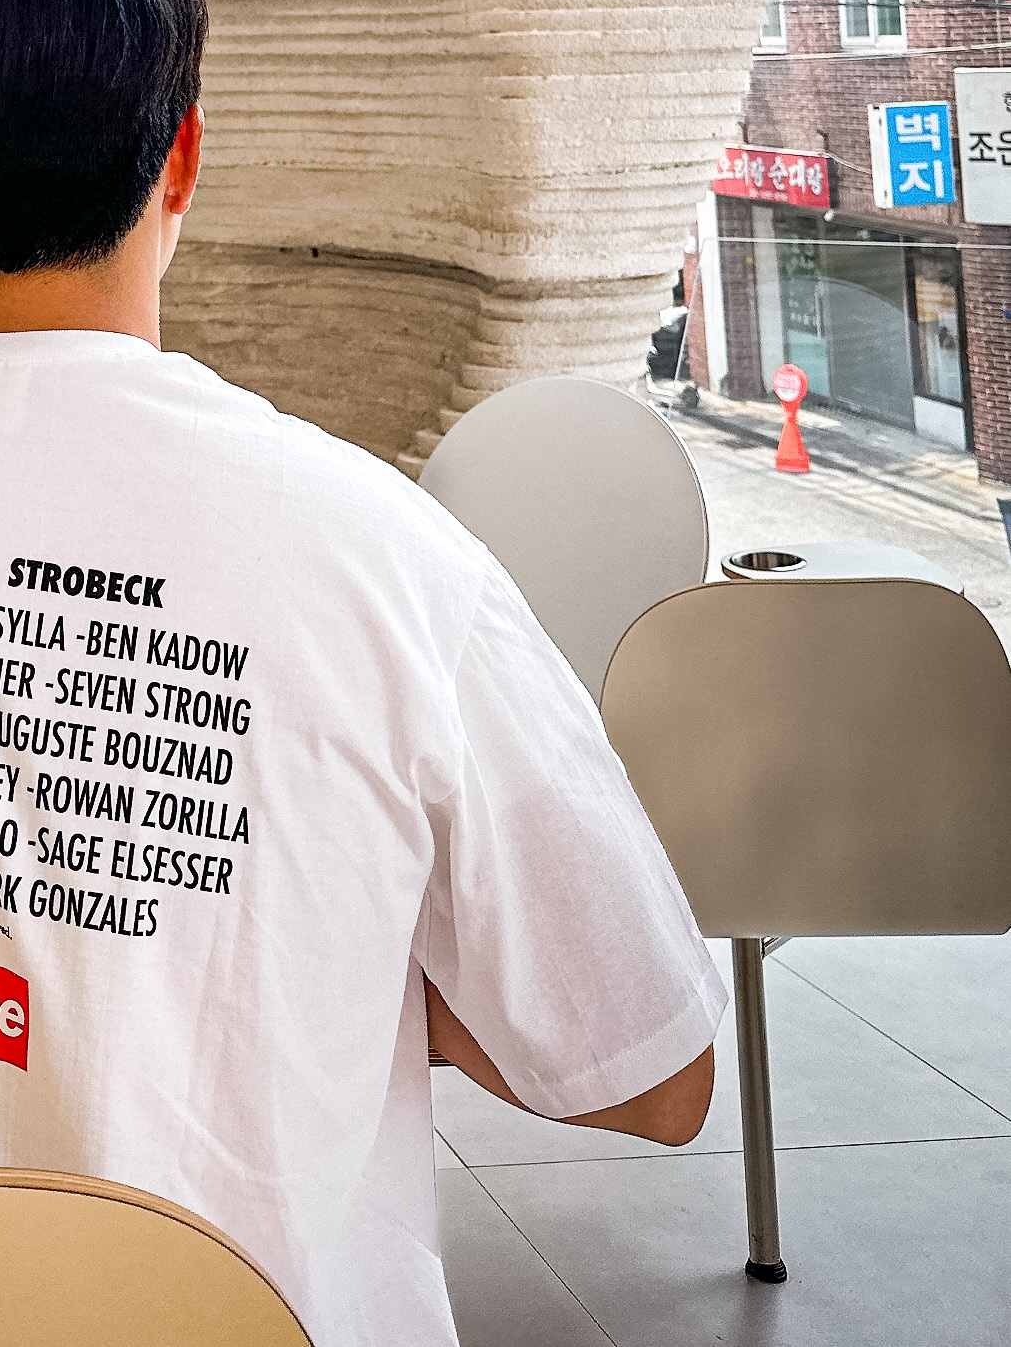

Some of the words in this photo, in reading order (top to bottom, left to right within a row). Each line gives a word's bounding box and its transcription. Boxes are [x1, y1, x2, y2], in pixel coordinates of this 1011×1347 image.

[895, 112, 945, 199] 벽지
[7, 557, 167, 609] STROBECK
[75, 620, 139, 662] -BEN
[146, 628, 250, 682] KADOW
[45, 667, 137, 715] -SEVEN
[144, 681, 252, 736] STRONG
[103, 728, 234, 786] BOUZNAD
[26, 772, 135, 824] -ROWAN
[140, 789, 250, 845] ZORILLA
[27, 826, 104, 875] -SAGE
[110, 839, 234, 895] ELSESSER
[28, 879, 159, 937] GONZALES
